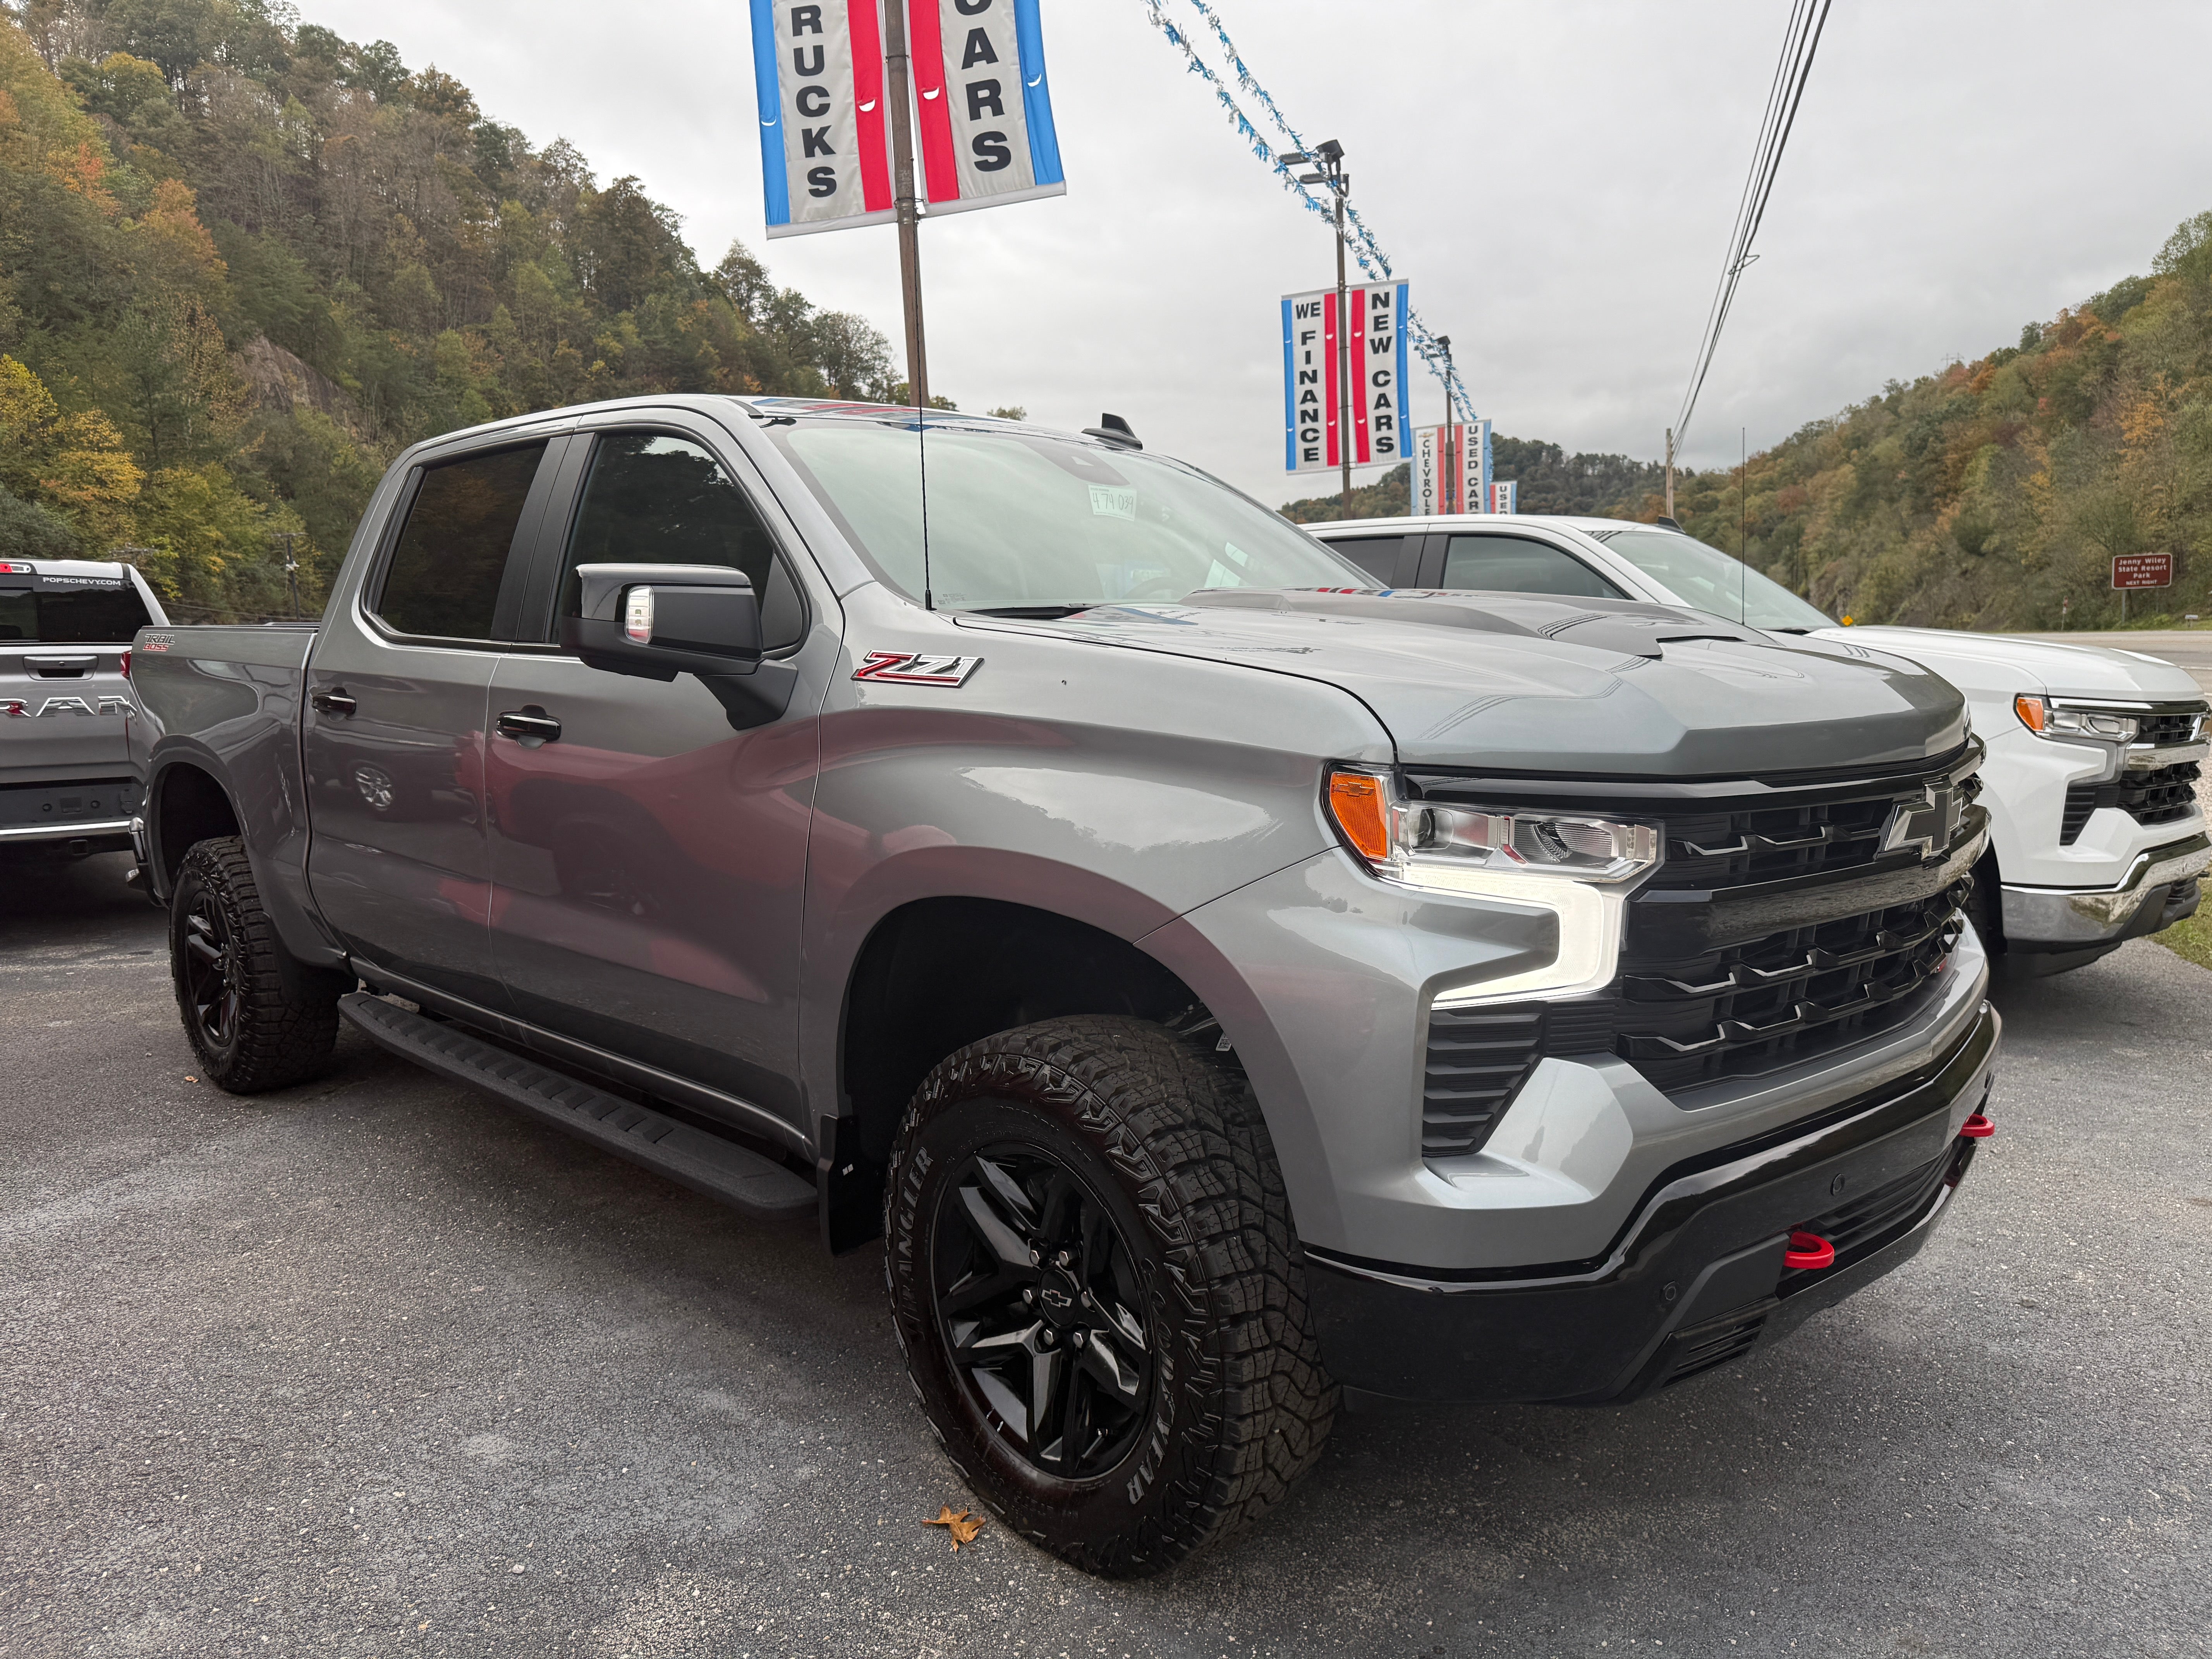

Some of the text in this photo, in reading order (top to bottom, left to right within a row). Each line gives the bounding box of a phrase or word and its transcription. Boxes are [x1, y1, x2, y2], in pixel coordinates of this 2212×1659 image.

[1296, 301, 1321, 319] WE
[1369, 292, 1394, 454] NEW CARS
[1299, 331, 1319, 462] FINANCE
[1468, 426, 1478, 514] USED CAR
[43, 577, 121, 586] POPSCHEVY.COM
[143, 643, 170, 651] BOSS
[144, 634, 175, 645] TRAIL
[850, 649, 985, 688] Z71
[898, 1146, 934, 1345] WRANGLER
